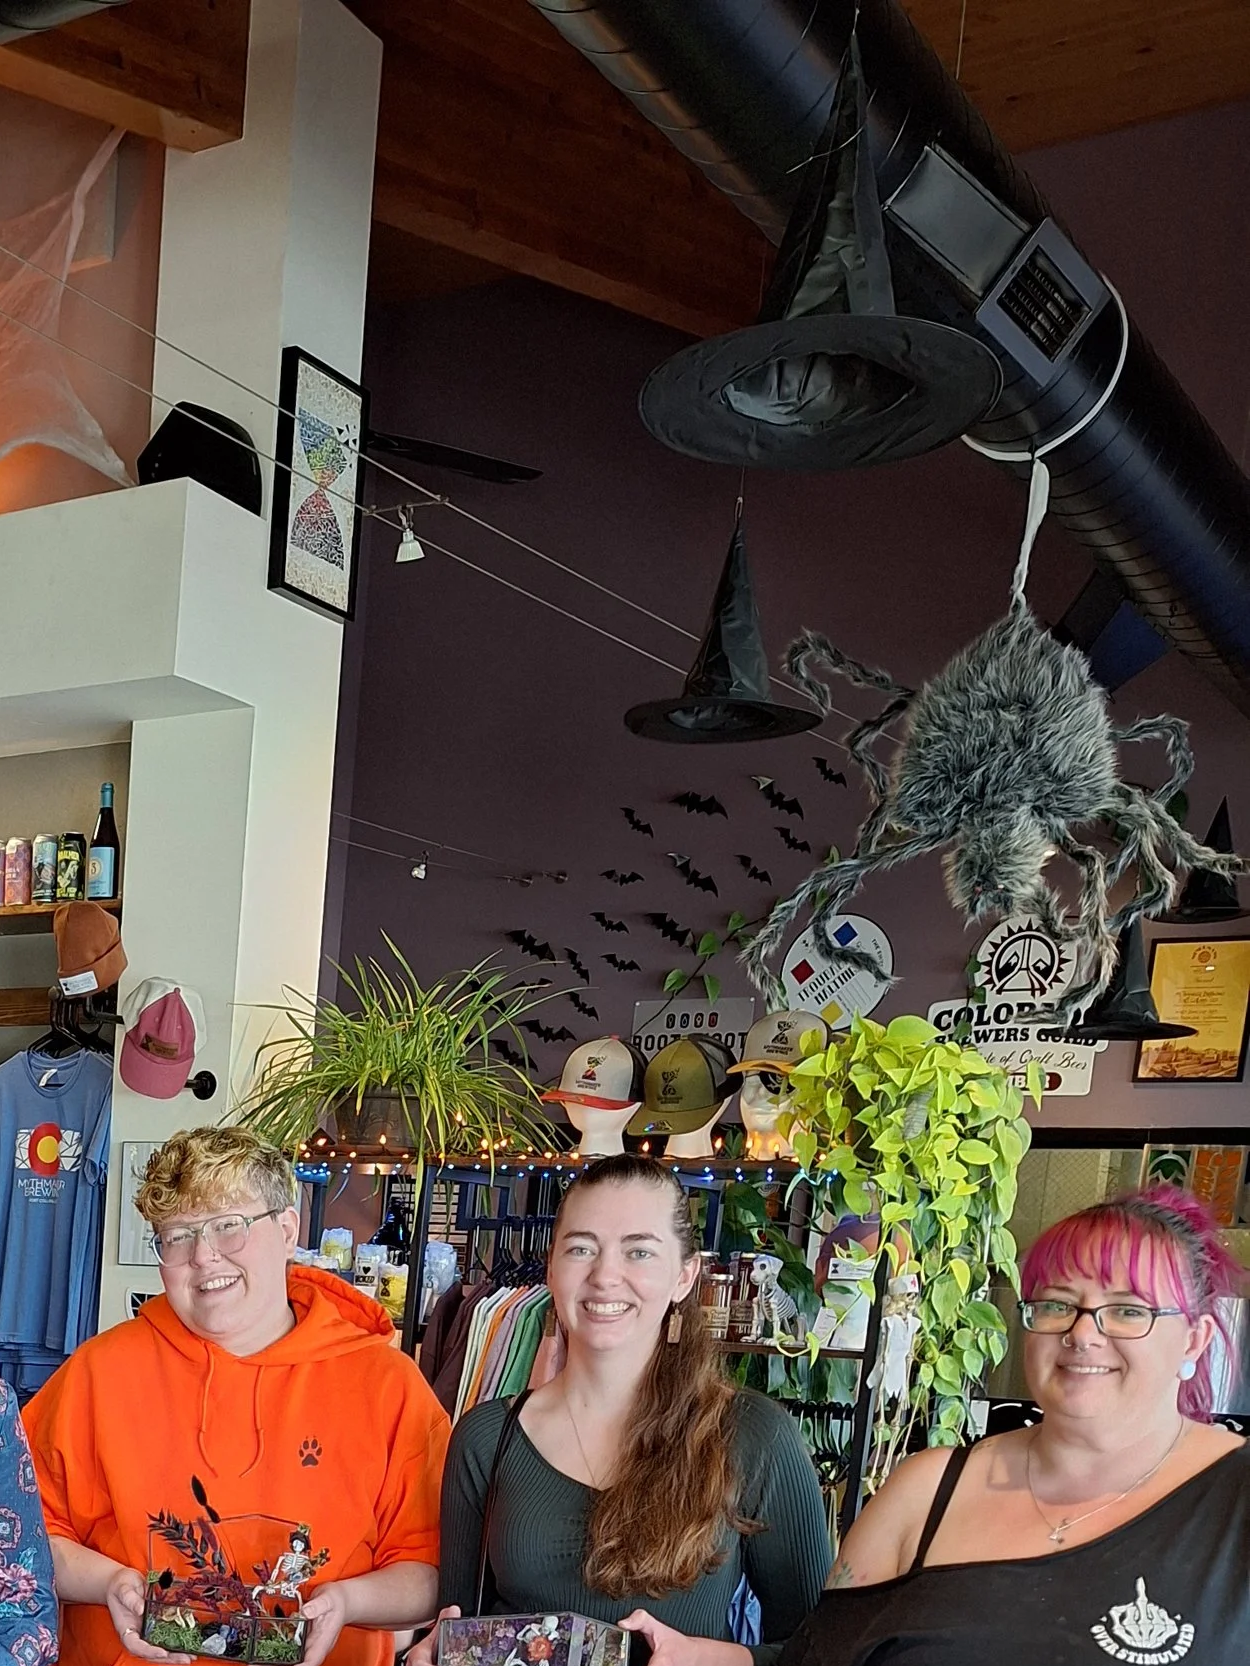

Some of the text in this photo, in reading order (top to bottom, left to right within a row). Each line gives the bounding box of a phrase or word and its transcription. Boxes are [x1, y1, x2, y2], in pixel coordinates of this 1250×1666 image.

[999, 1051, 1015, 1069] of
[1019, 1050, 1051, 1065] Craft
[1054, 1051, 1089, 1071] Beer
[1090, 1623, 1195, 1666] OVERSTIMULATED
